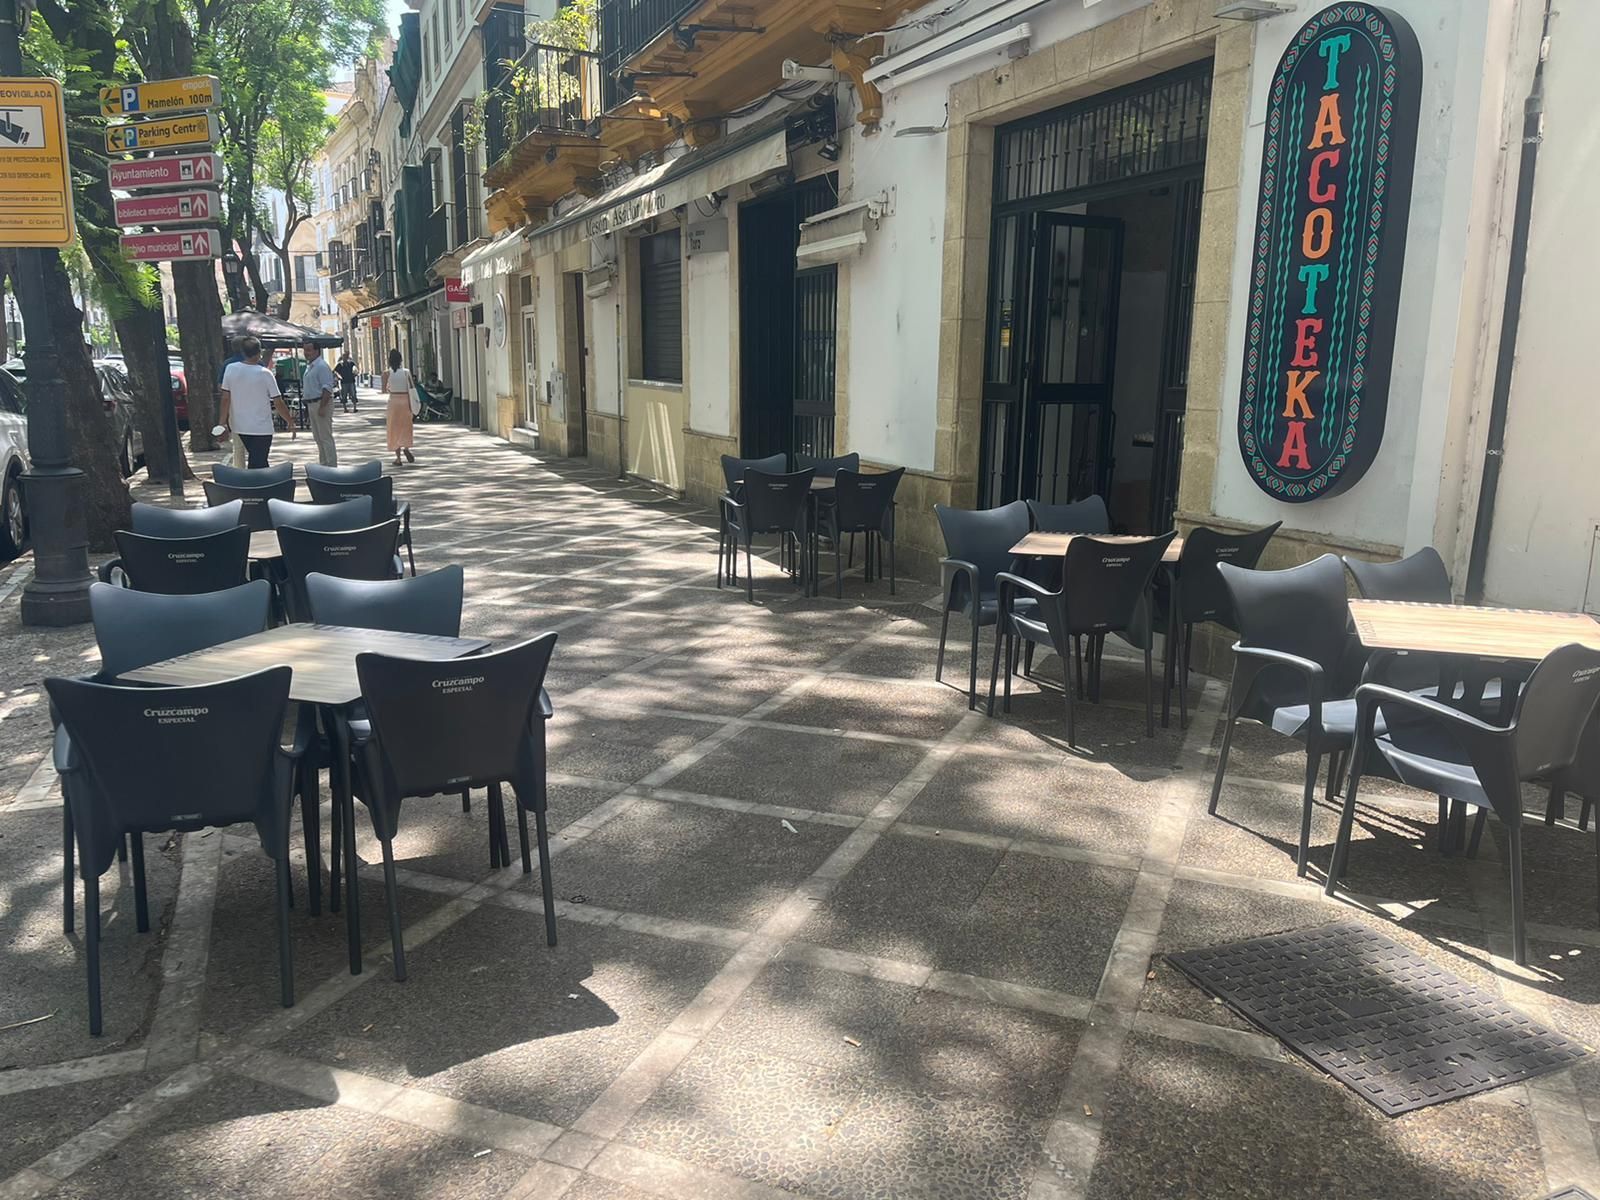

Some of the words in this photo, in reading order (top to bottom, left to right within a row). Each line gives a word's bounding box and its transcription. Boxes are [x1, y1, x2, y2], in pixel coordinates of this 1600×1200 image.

[122, 88, 136, 111] P
[147, 97, 184, 109] Mamelón
[189, 93, 213, 104] 100m
[138, 126, 171, 138] Parking
[172, 122, 204, 135] Centr
[112, 167, 169, 182] Ayuntamiento
[148, 205, 178, 216] municipal
[147, 241, 179, 253] municipal
[1276, 33, 1351, 469] TACOTEKA
[432, 676, 485, 688] Cruzcampo
[442, 686, 473, 694] ESPECIAL
[144, 707, 209, 717] Cruzcampo
